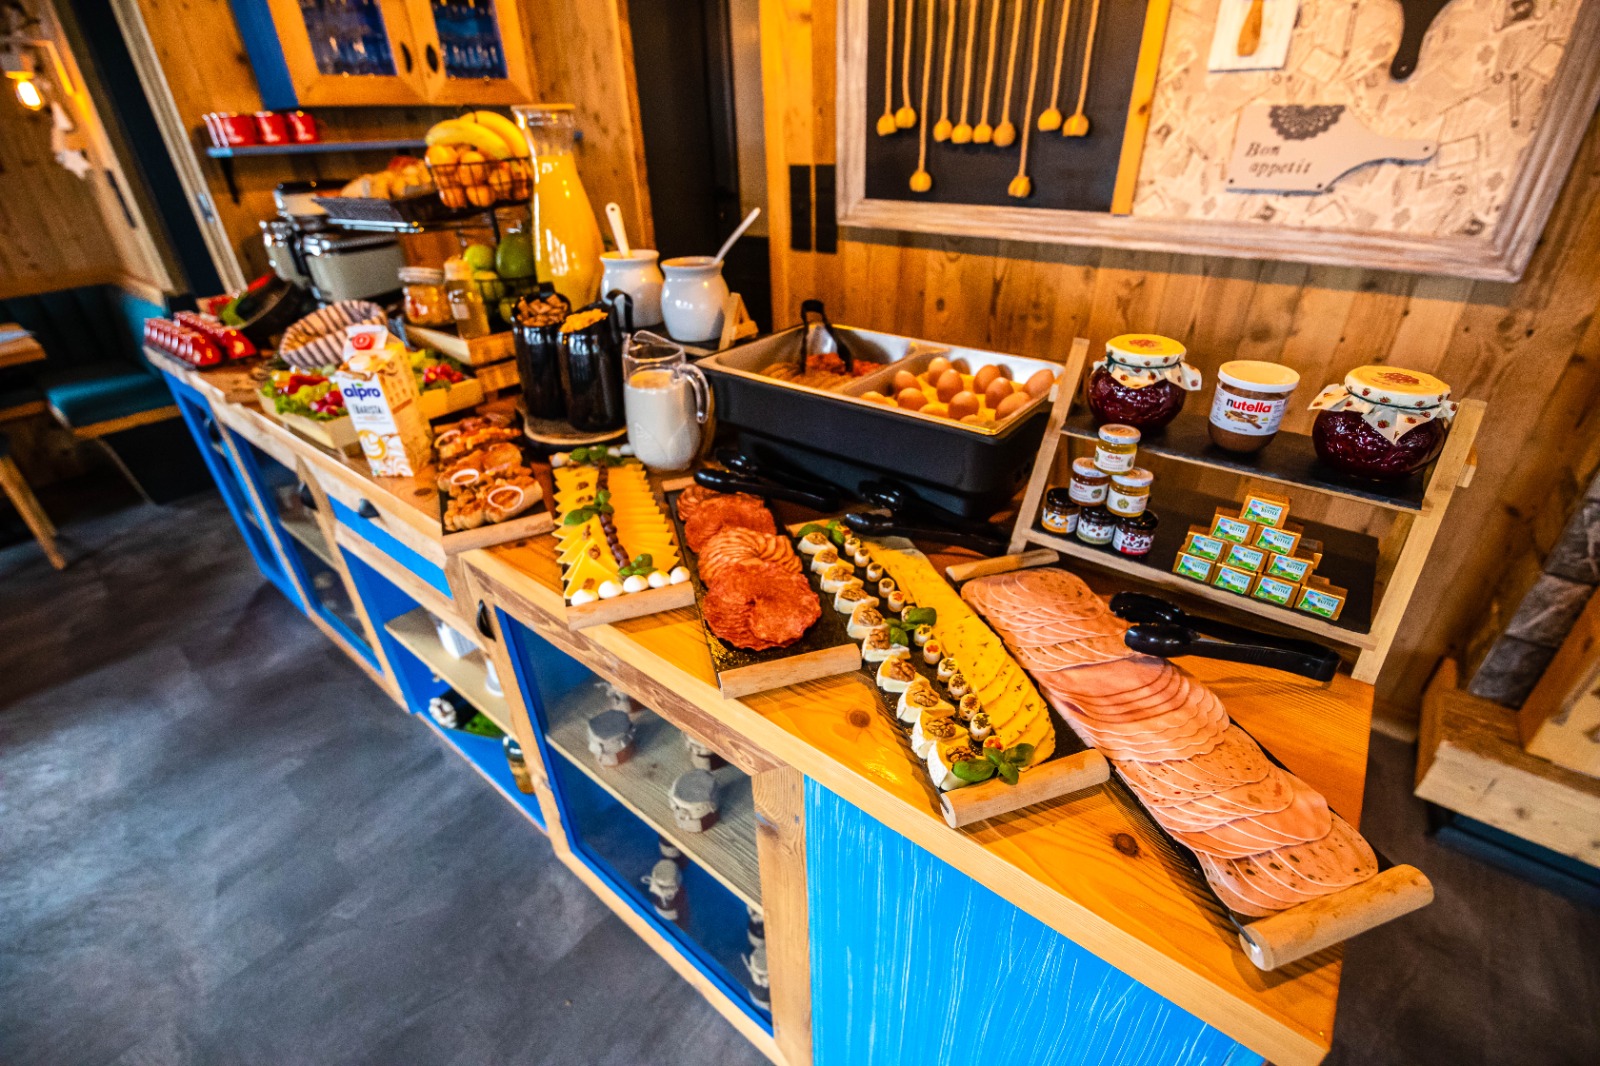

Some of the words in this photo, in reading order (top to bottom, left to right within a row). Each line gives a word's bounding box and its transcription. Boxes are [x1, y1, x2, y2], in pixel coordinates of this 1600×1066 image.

[1245, 142, 1280, 157] Bon
[1249, 158, 1312, 177] appetit
[343, 383, 381, 401] alpro
[1226, 398, 1272, 413] nutella
